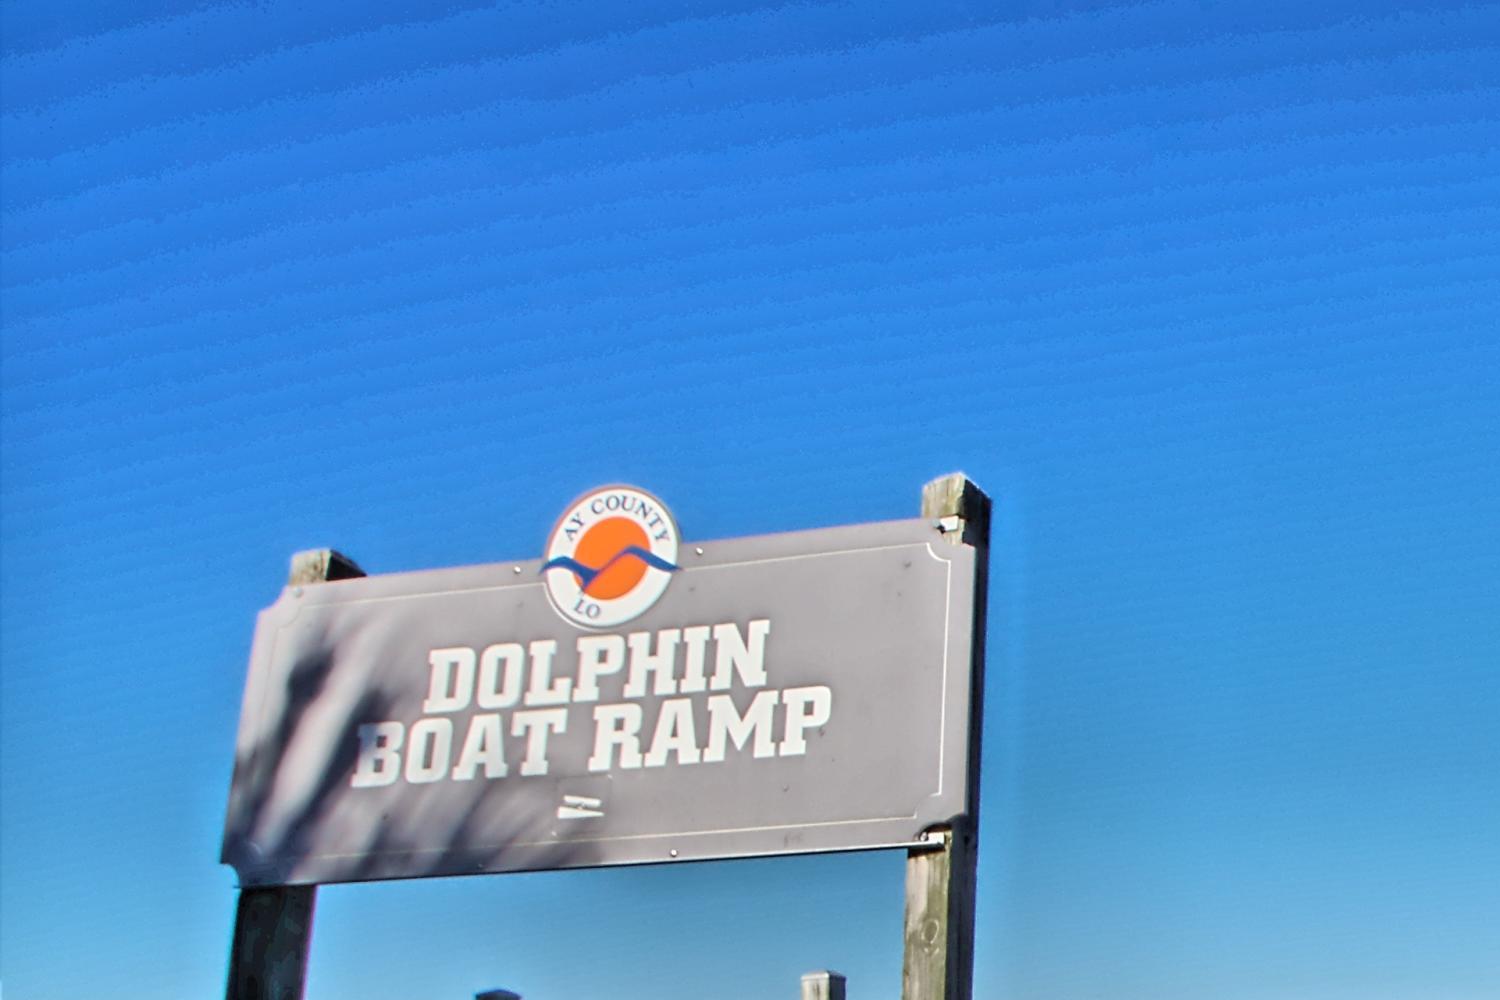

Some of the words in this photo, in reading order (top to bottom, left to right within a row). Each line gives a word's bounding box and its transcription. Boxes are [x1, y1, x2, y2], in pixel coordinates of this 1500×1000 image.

[591, 495, 670, 542] COUNTY
[423, 619, 770, 713] DOLPHIN
[351, 708, 568, 787] BOAT
[588, 685, 831, 772] RAMP
